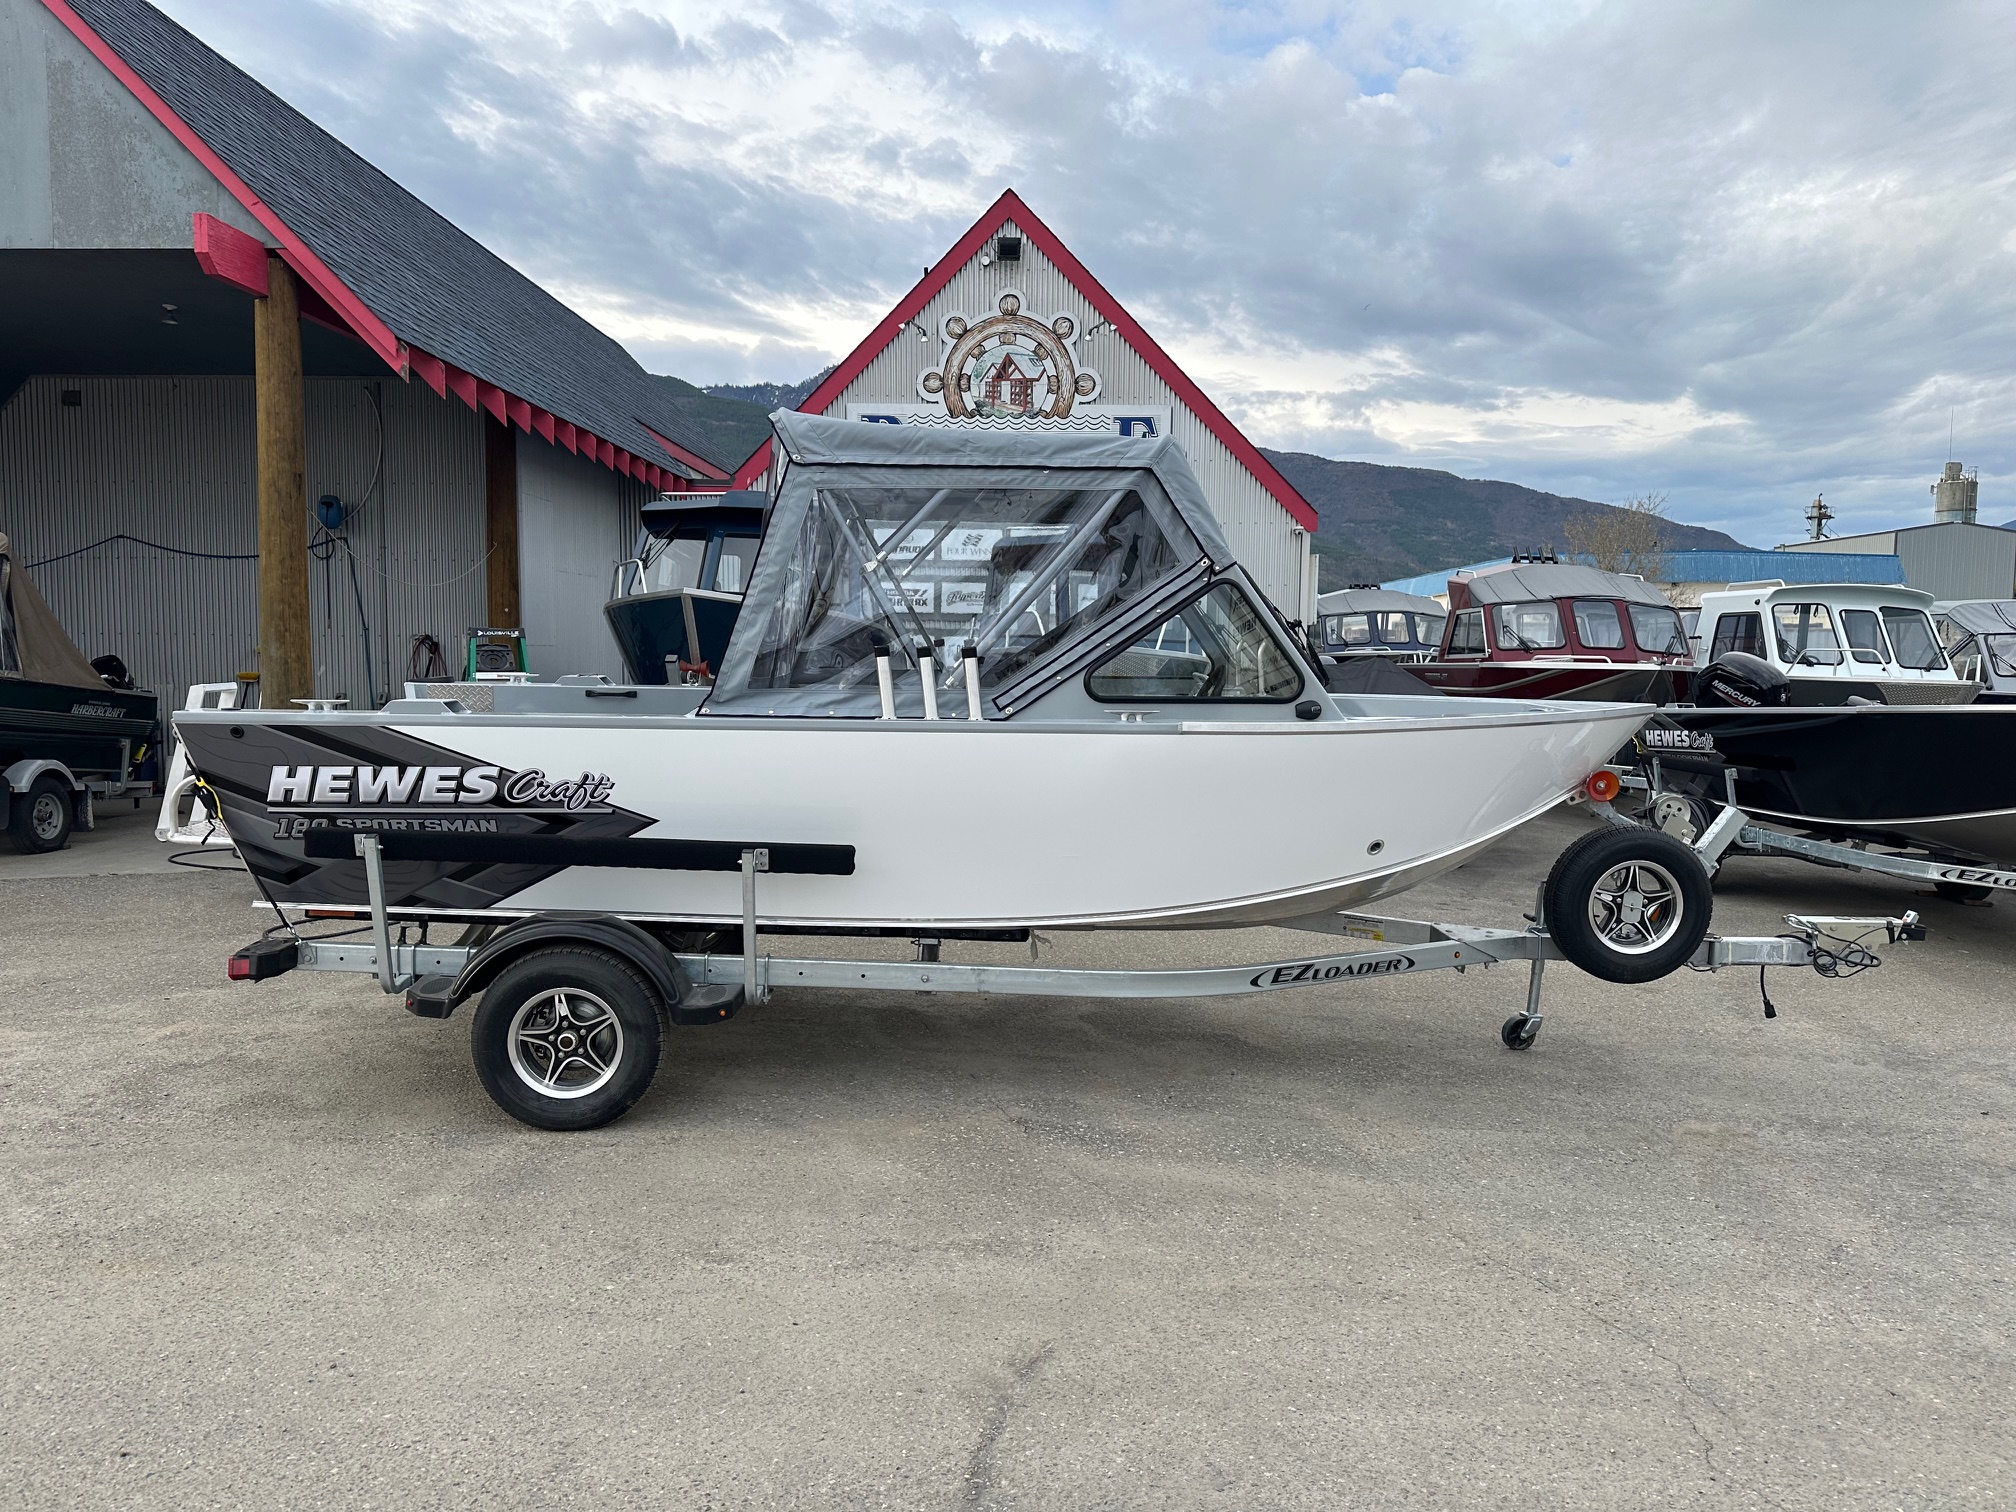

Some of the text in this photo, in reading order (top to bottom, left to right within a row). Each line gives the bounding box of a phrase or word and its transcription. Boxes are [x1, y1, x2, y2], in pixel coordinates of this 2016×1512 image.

[969, 547, 992, 555] WINN
[1711, 679, 1762, 707] MERCURY
[70, 703, 127, 718] HARBERCRAFT
[1645, 729, 1714, 752] HEWES Craft
[266, 765, 615, 811] HEWES Craft
[336, 818, 499, 833] SPORTSMAN
